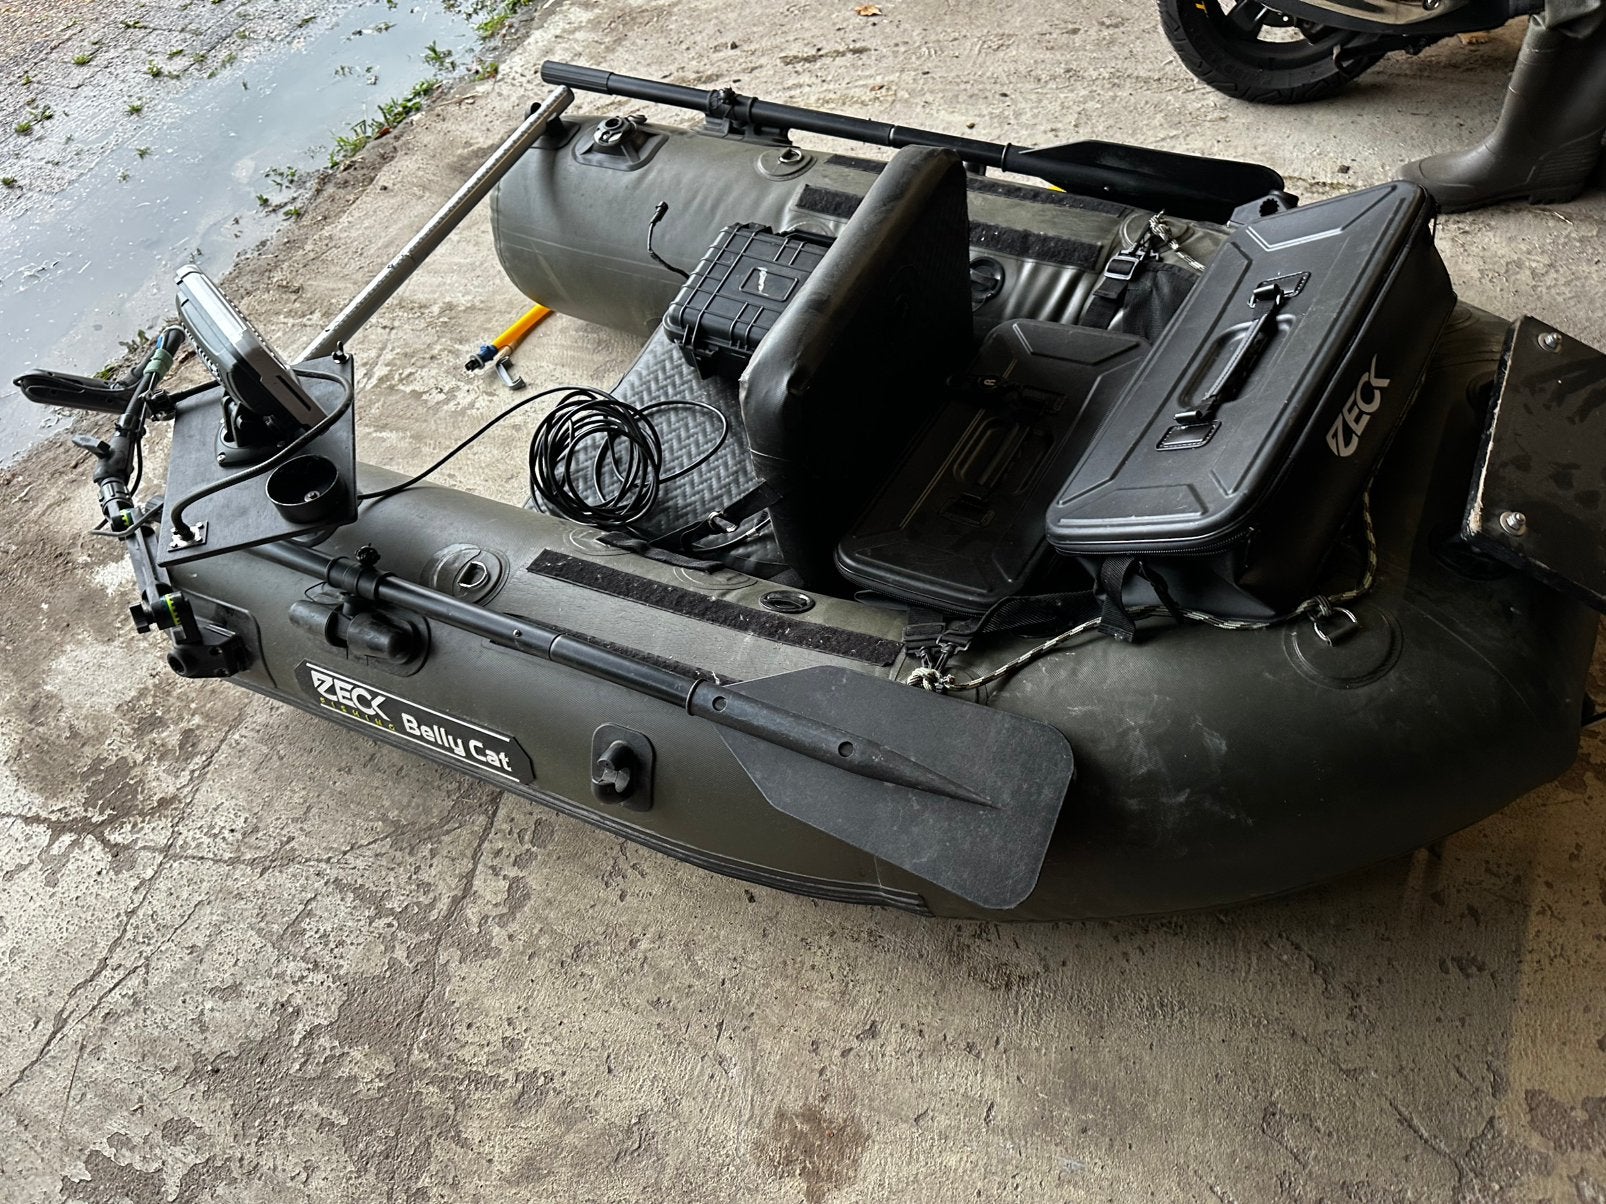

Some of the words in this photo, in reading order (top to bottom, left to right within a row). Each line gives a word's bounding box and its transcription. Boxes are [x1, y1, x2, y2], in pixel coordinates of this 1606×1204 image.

[1326, 353, 1391, 457] ZECK
[310, 670, 391, 721] ZECK
[401, 712, 467, 757] Belly
[468, 739, 513, 772] Cat
